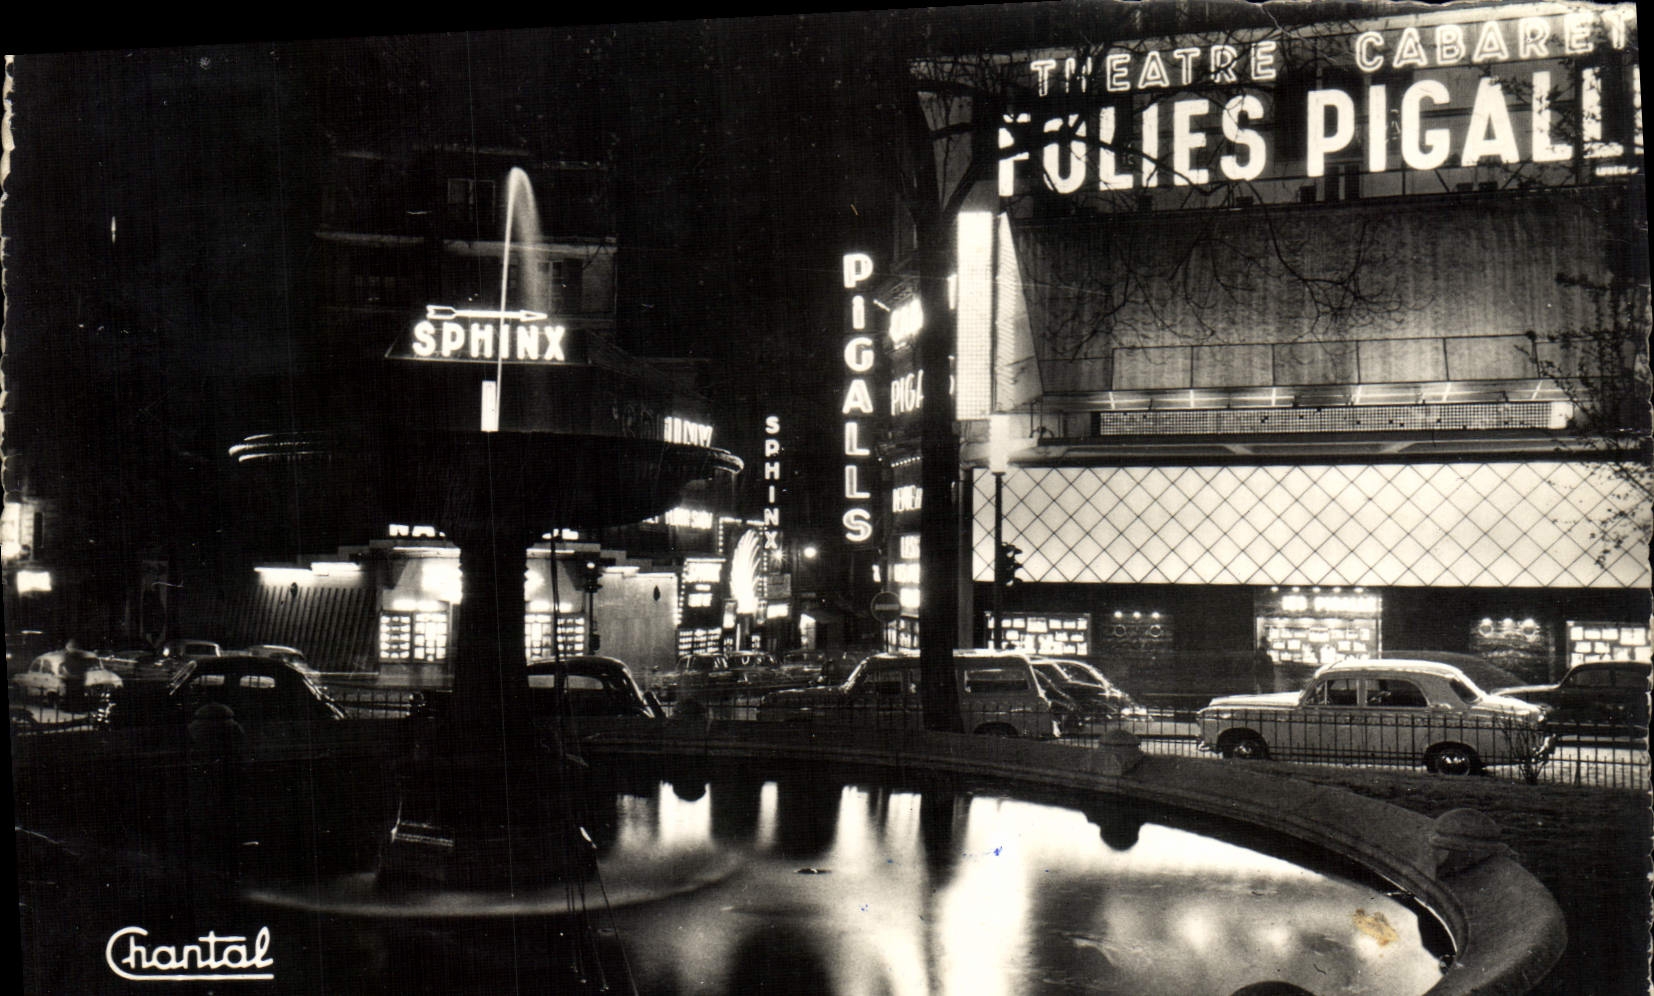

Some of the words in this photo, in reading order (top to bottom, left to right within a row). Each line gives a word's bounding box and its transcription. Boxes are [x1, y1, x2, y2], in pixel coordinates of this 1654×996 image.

[1029, 41, 1277, 97] THEATRE
[1355, 8, 1636, 73] CABARET
[998, 95, 1268, 197] FOLIES
[1307, 64, 1645, 177] PIGALL
[412, 320, 566, 362] SPHINX
[842, 253, 874, 542] PIGALLS
[763, 416, 781, 549] SPHINX
